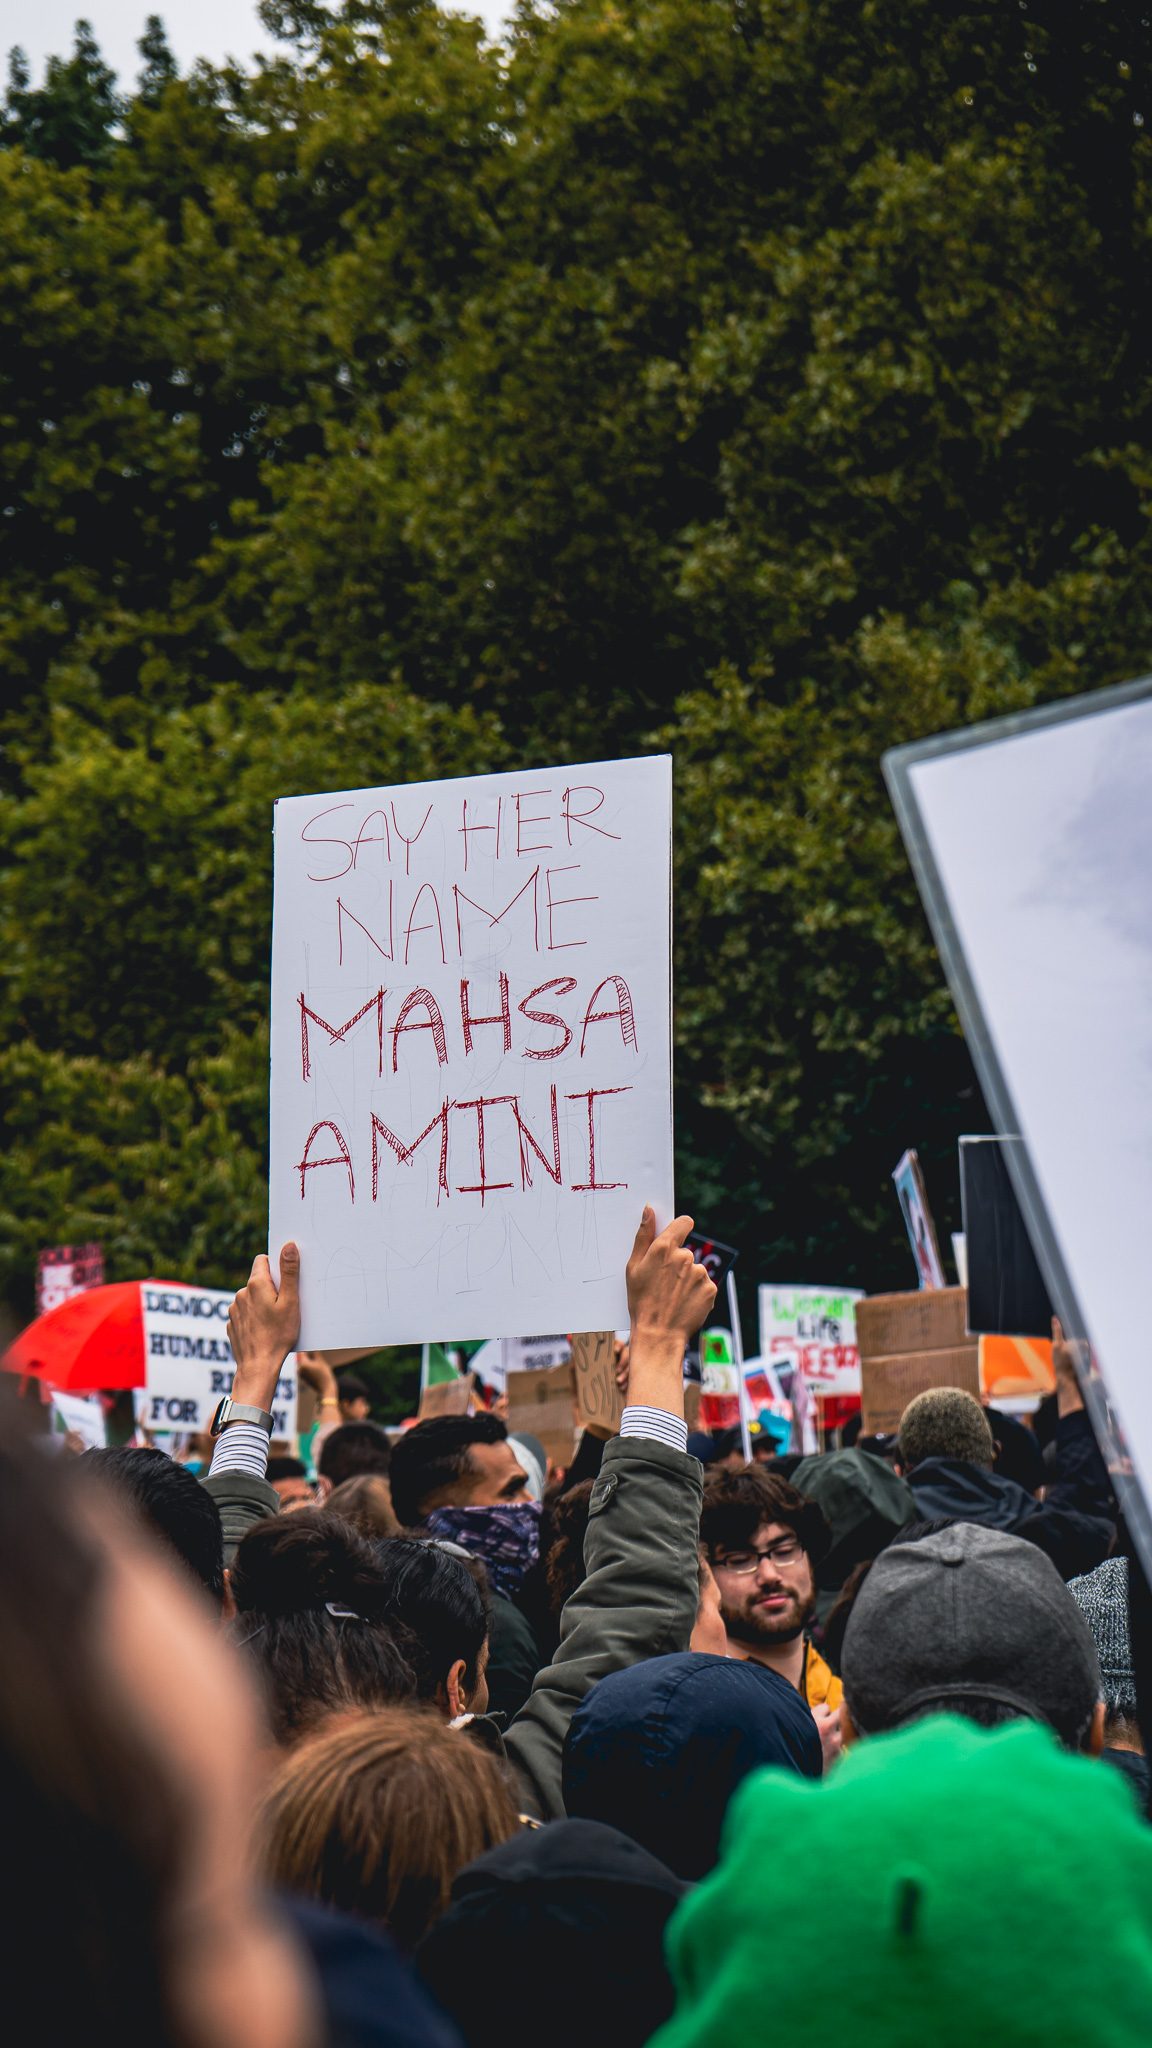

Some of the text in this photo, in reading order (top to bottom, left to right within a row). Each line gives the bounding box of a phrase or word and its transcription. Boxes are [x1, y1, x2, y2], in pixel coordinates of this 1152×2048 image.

[301, 786, 622, 882] SAY HER
[336, 865, 599, 965] NAME
[296, 971, 639, 1082] MAHSA
[293, 1084, 634, 1208] AMINI
[145, 1291, 232, 1320] DEMOC
[150, 1396, 198, 1423] FOR
